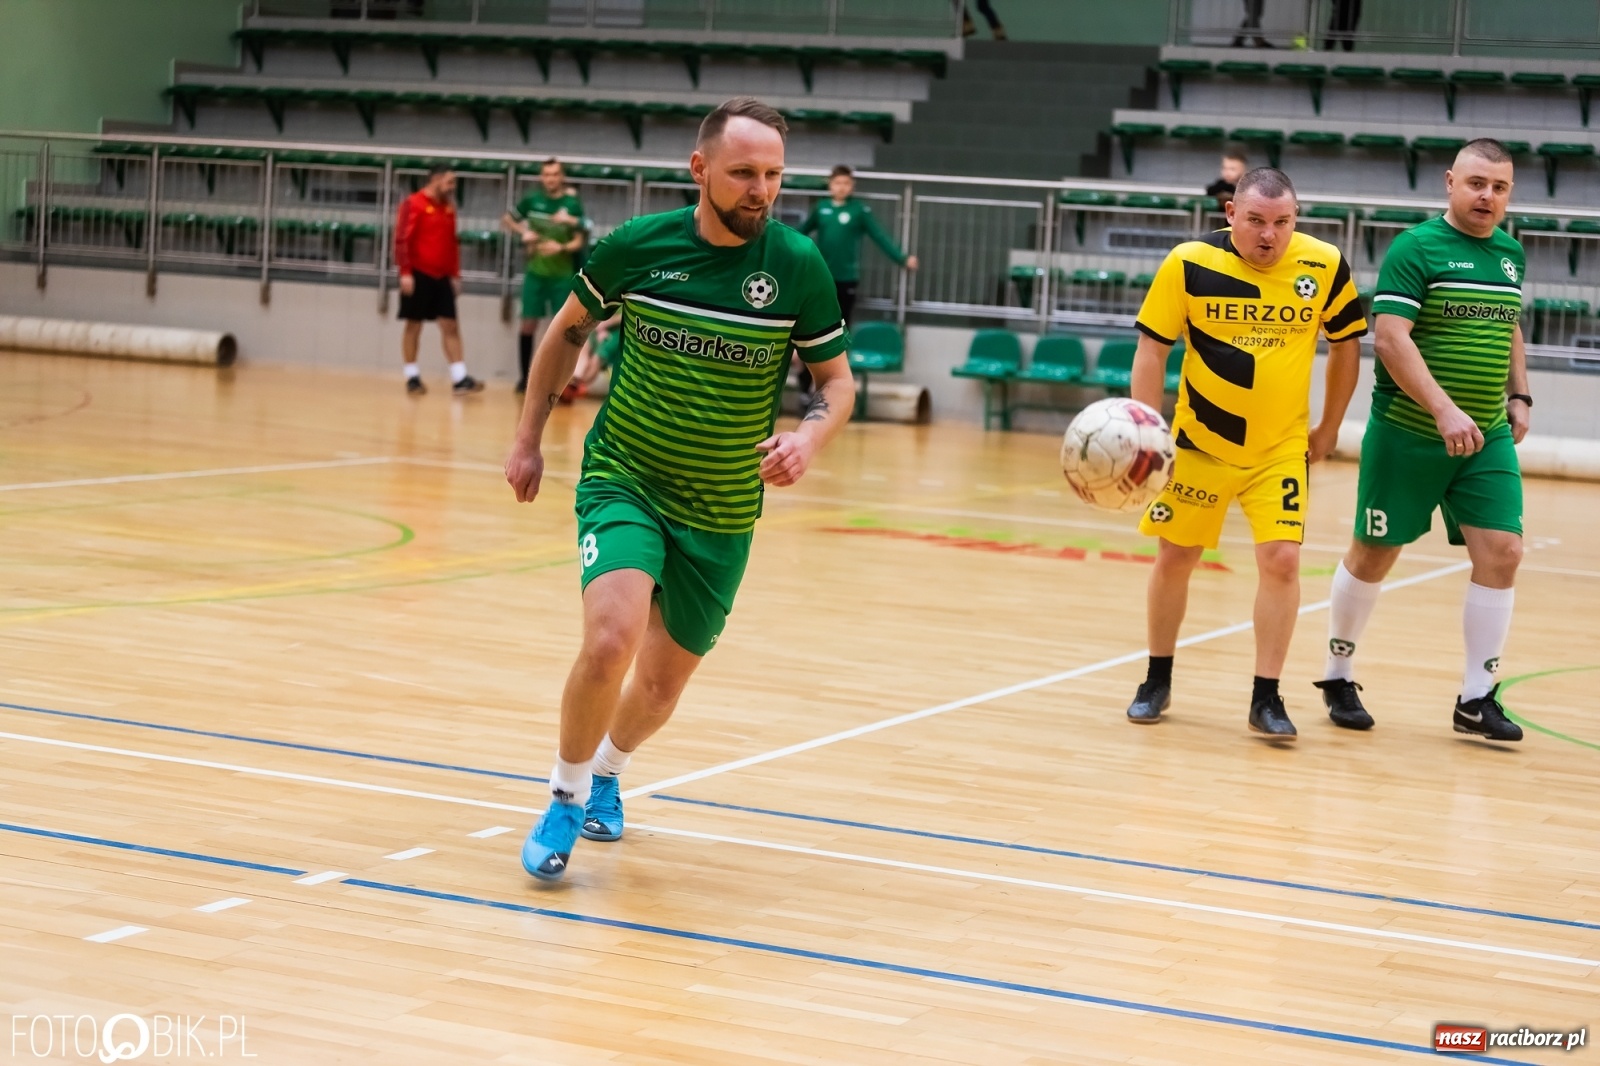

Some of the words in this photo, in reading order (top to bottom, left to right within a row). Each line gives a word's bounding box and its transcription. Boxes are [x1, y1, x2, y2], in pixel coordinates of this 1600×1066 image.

[1206, 303, 1313, 323] HERZOG
[635, 316, 775, 369] kosiarka.pl
[1231, 335, 1286, 348] 602392876
[1251, 325, 1288, 335] Agencja
[1166, 479, 1219, 504] ERZOG
[1281, 477, 1300, 512] 2
[1365, 507, 1389, 538] 13
